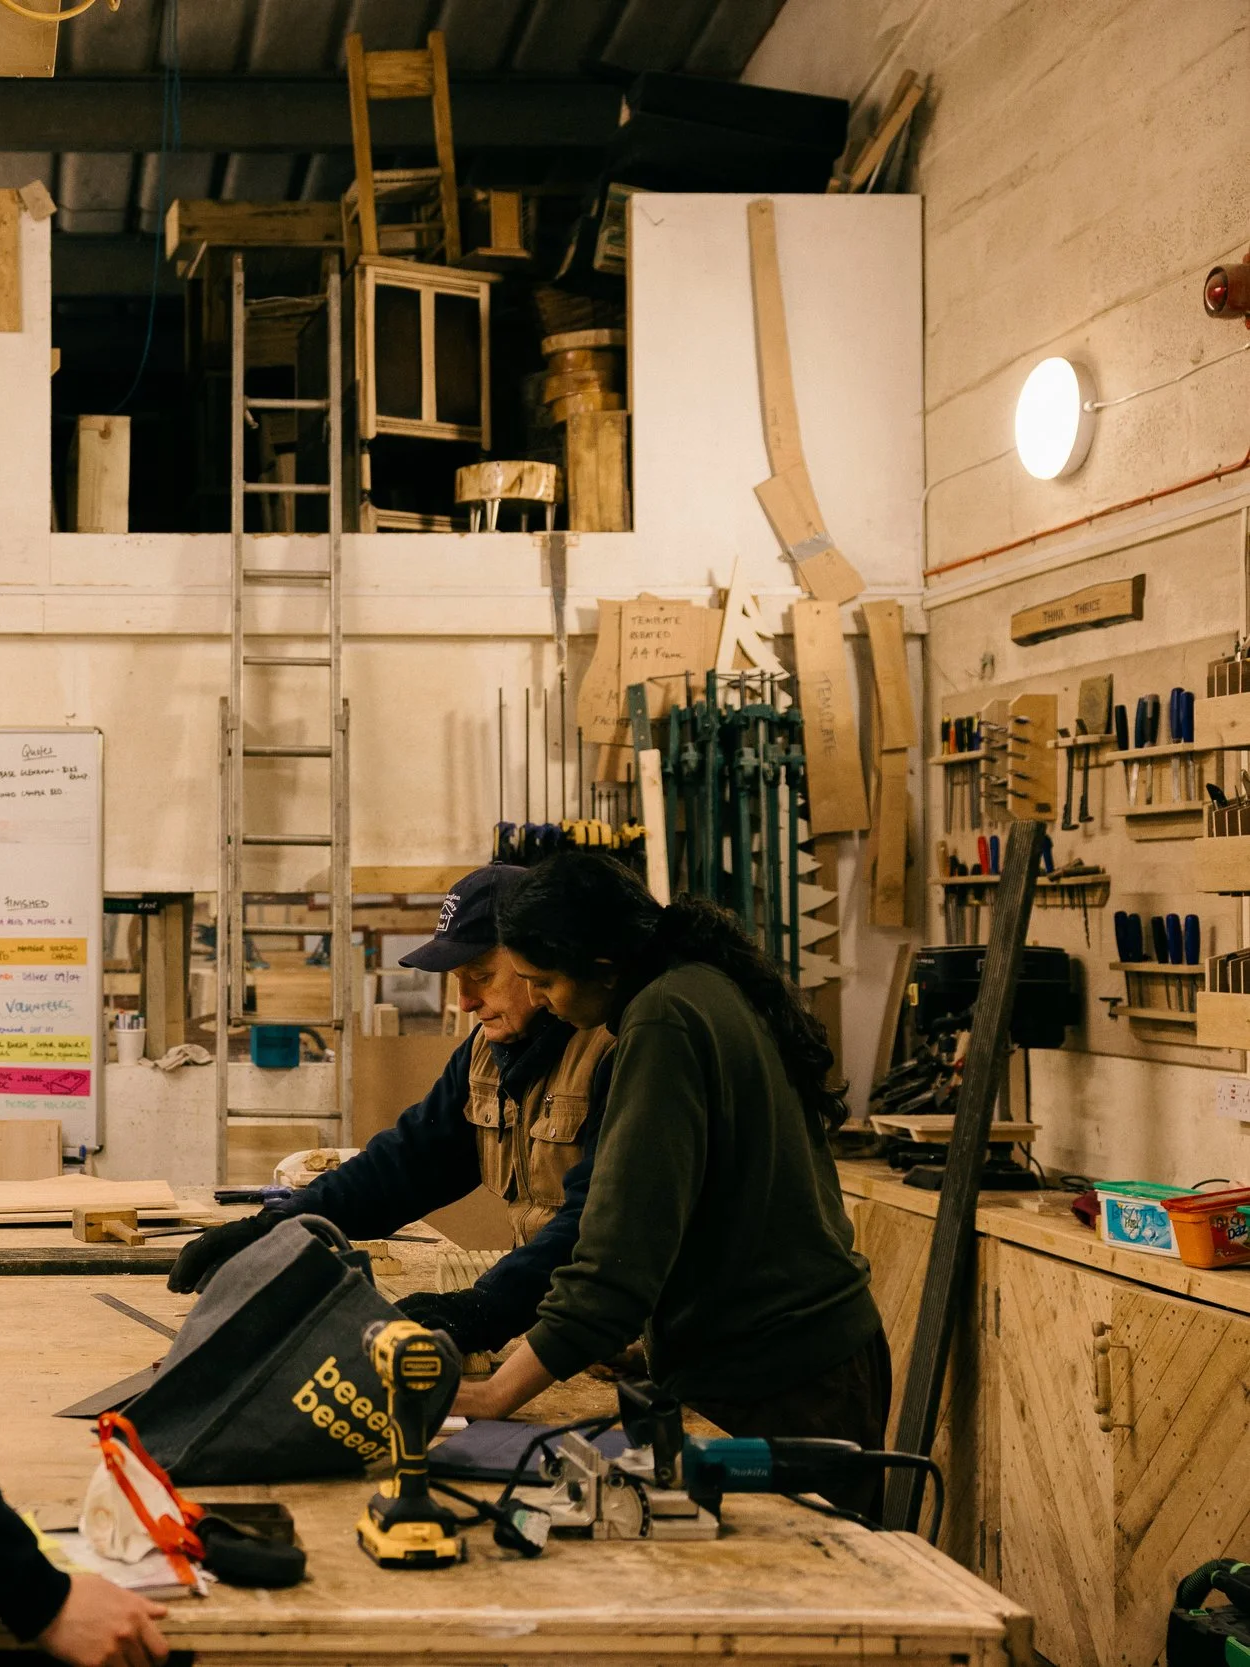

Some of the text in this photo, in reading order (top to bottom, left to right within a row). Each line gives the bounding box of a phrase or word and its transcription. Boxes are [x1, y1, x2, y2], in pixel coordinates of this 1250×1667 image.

[1042, 599, 1101, 624] THINK THRICE
[631, 615, 682, 626] TEMPLATE
[630, 646, 649, 660] A4
[21, 743, 53, 758] Quotes
[1228, 1224, 1247, 1240] Daz
